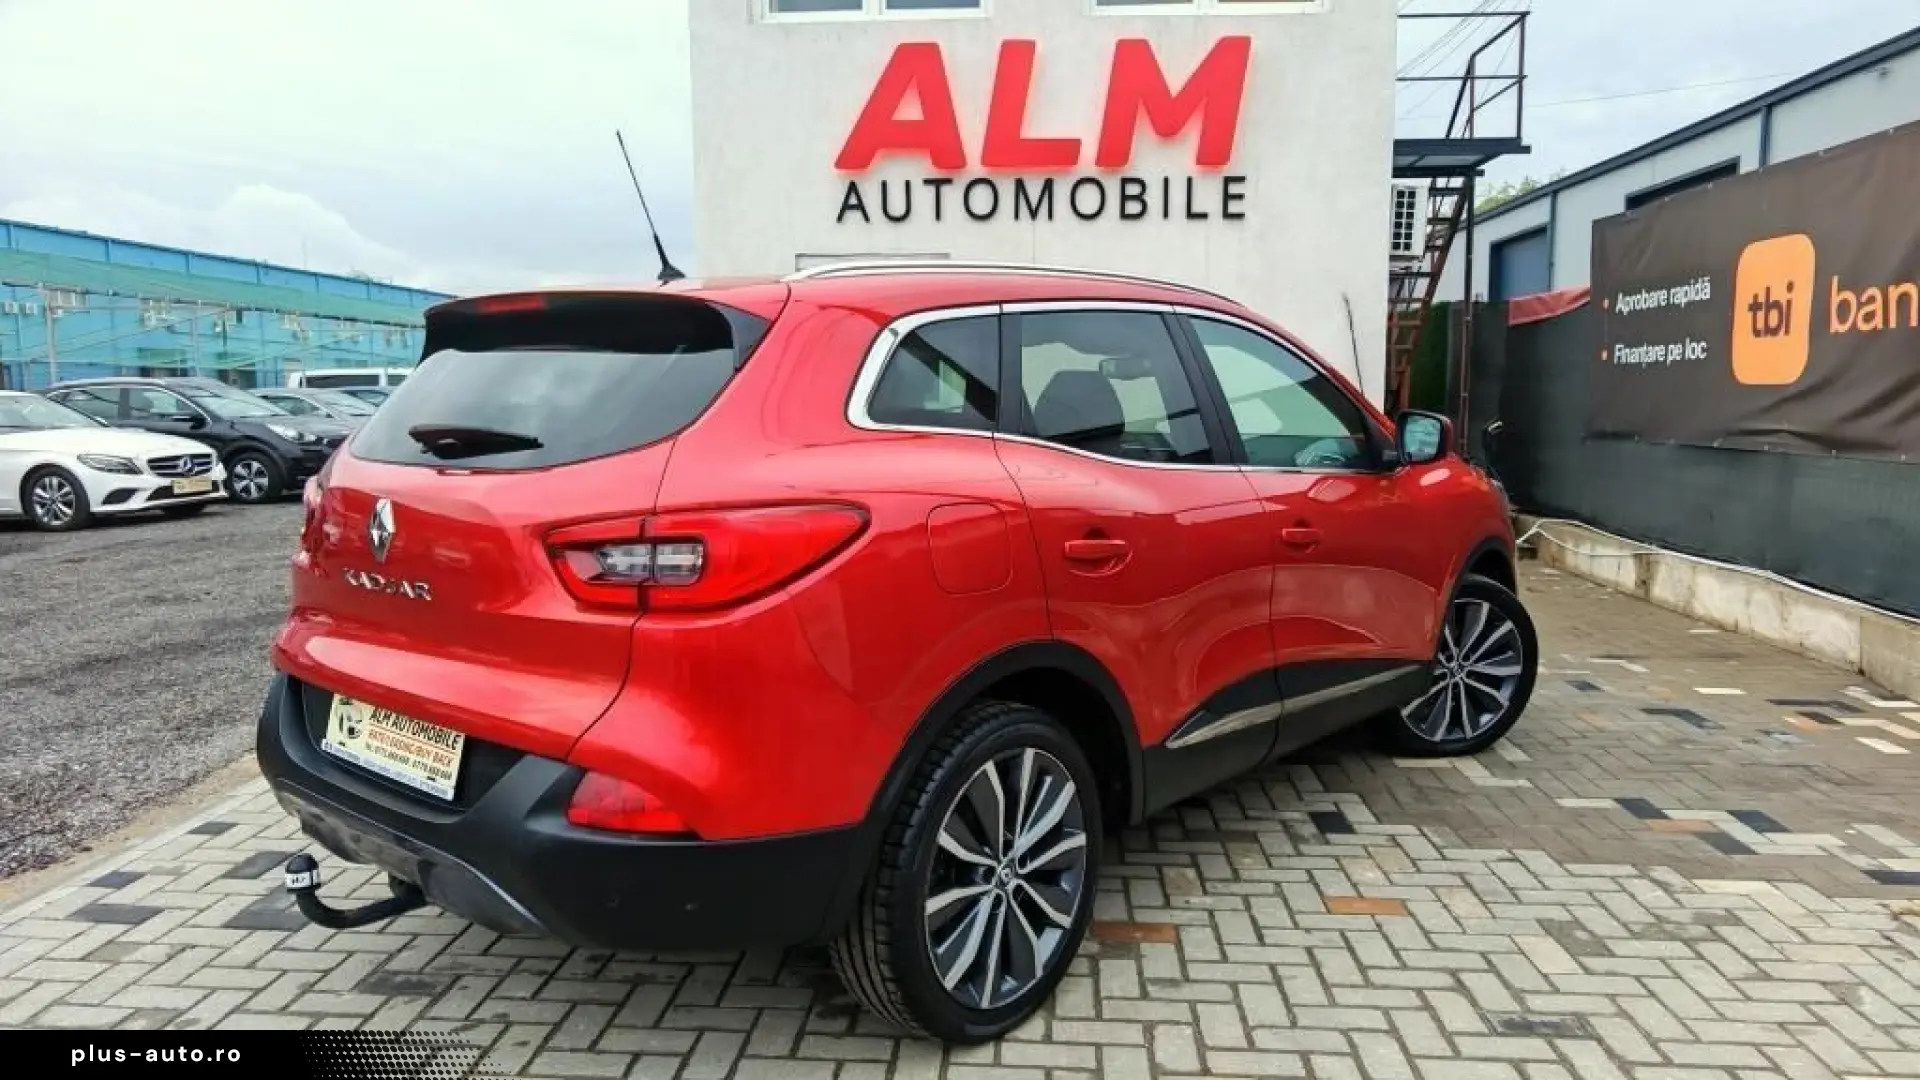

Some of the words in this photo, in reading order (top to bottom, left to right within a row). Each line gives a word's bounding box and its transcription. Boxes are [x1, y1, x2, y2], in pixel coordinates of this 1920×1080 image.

[835, 36, 1252, 168] ALM
[837, 176, 1246, 223] AUTOMOBILE
[1615, 285, 1668, 314] Aprobare
[1669, 275, 1711, 309] rapidă
[1747, 281, 1794, 338] tbi
[1613, 343, 1664, 367] Finanțare
[1666, 344, 1683, 368] pe
[1685, 337, 1707, 361] loc
[369, 707, 392, 727] ALM
[391, 712, 462, 750] AUTOMOBILE
